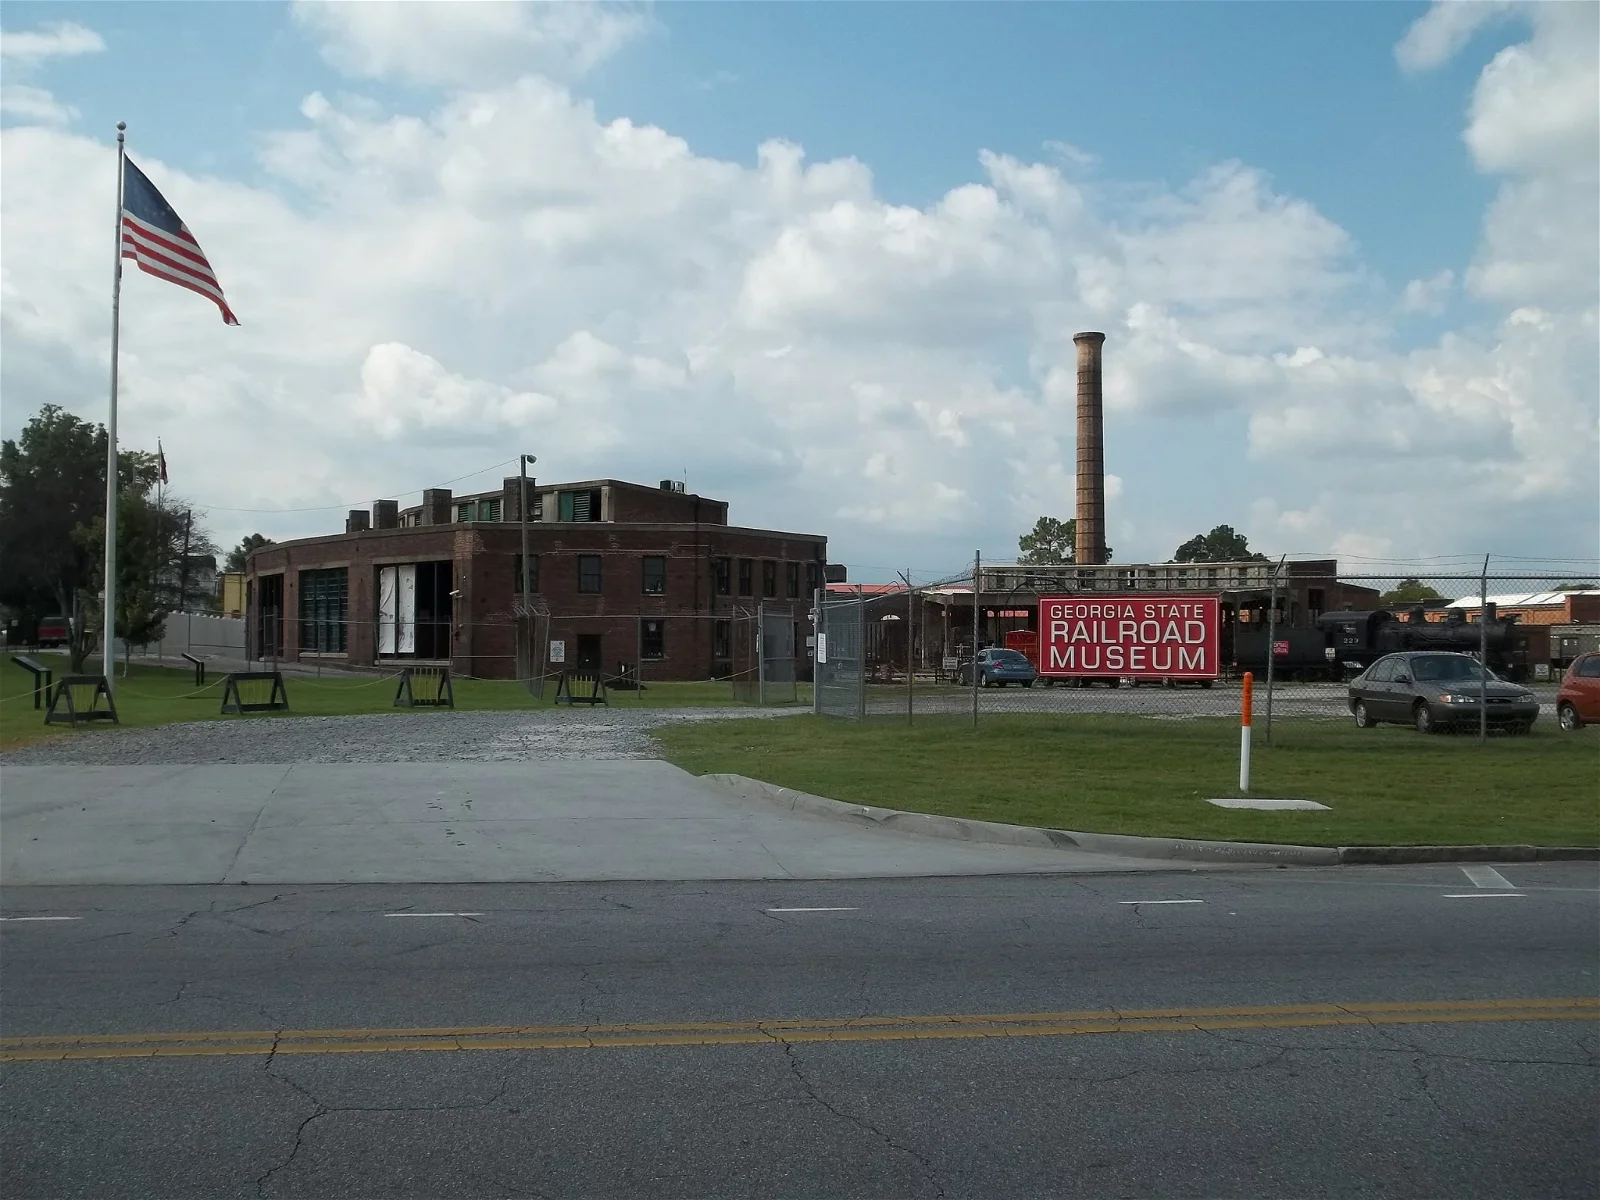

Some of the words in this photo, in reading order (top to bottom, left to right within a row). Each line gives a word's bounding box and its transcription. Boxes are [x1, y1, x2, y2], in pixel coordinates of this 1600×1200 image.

[1050, 605, 1135, 619] GEORGIA
[1144, 604, 1204, 618] STATE
[1050, 620, 1206, 644] RAILROAD
[1050, 646, 1205, 670] MUSEUM
